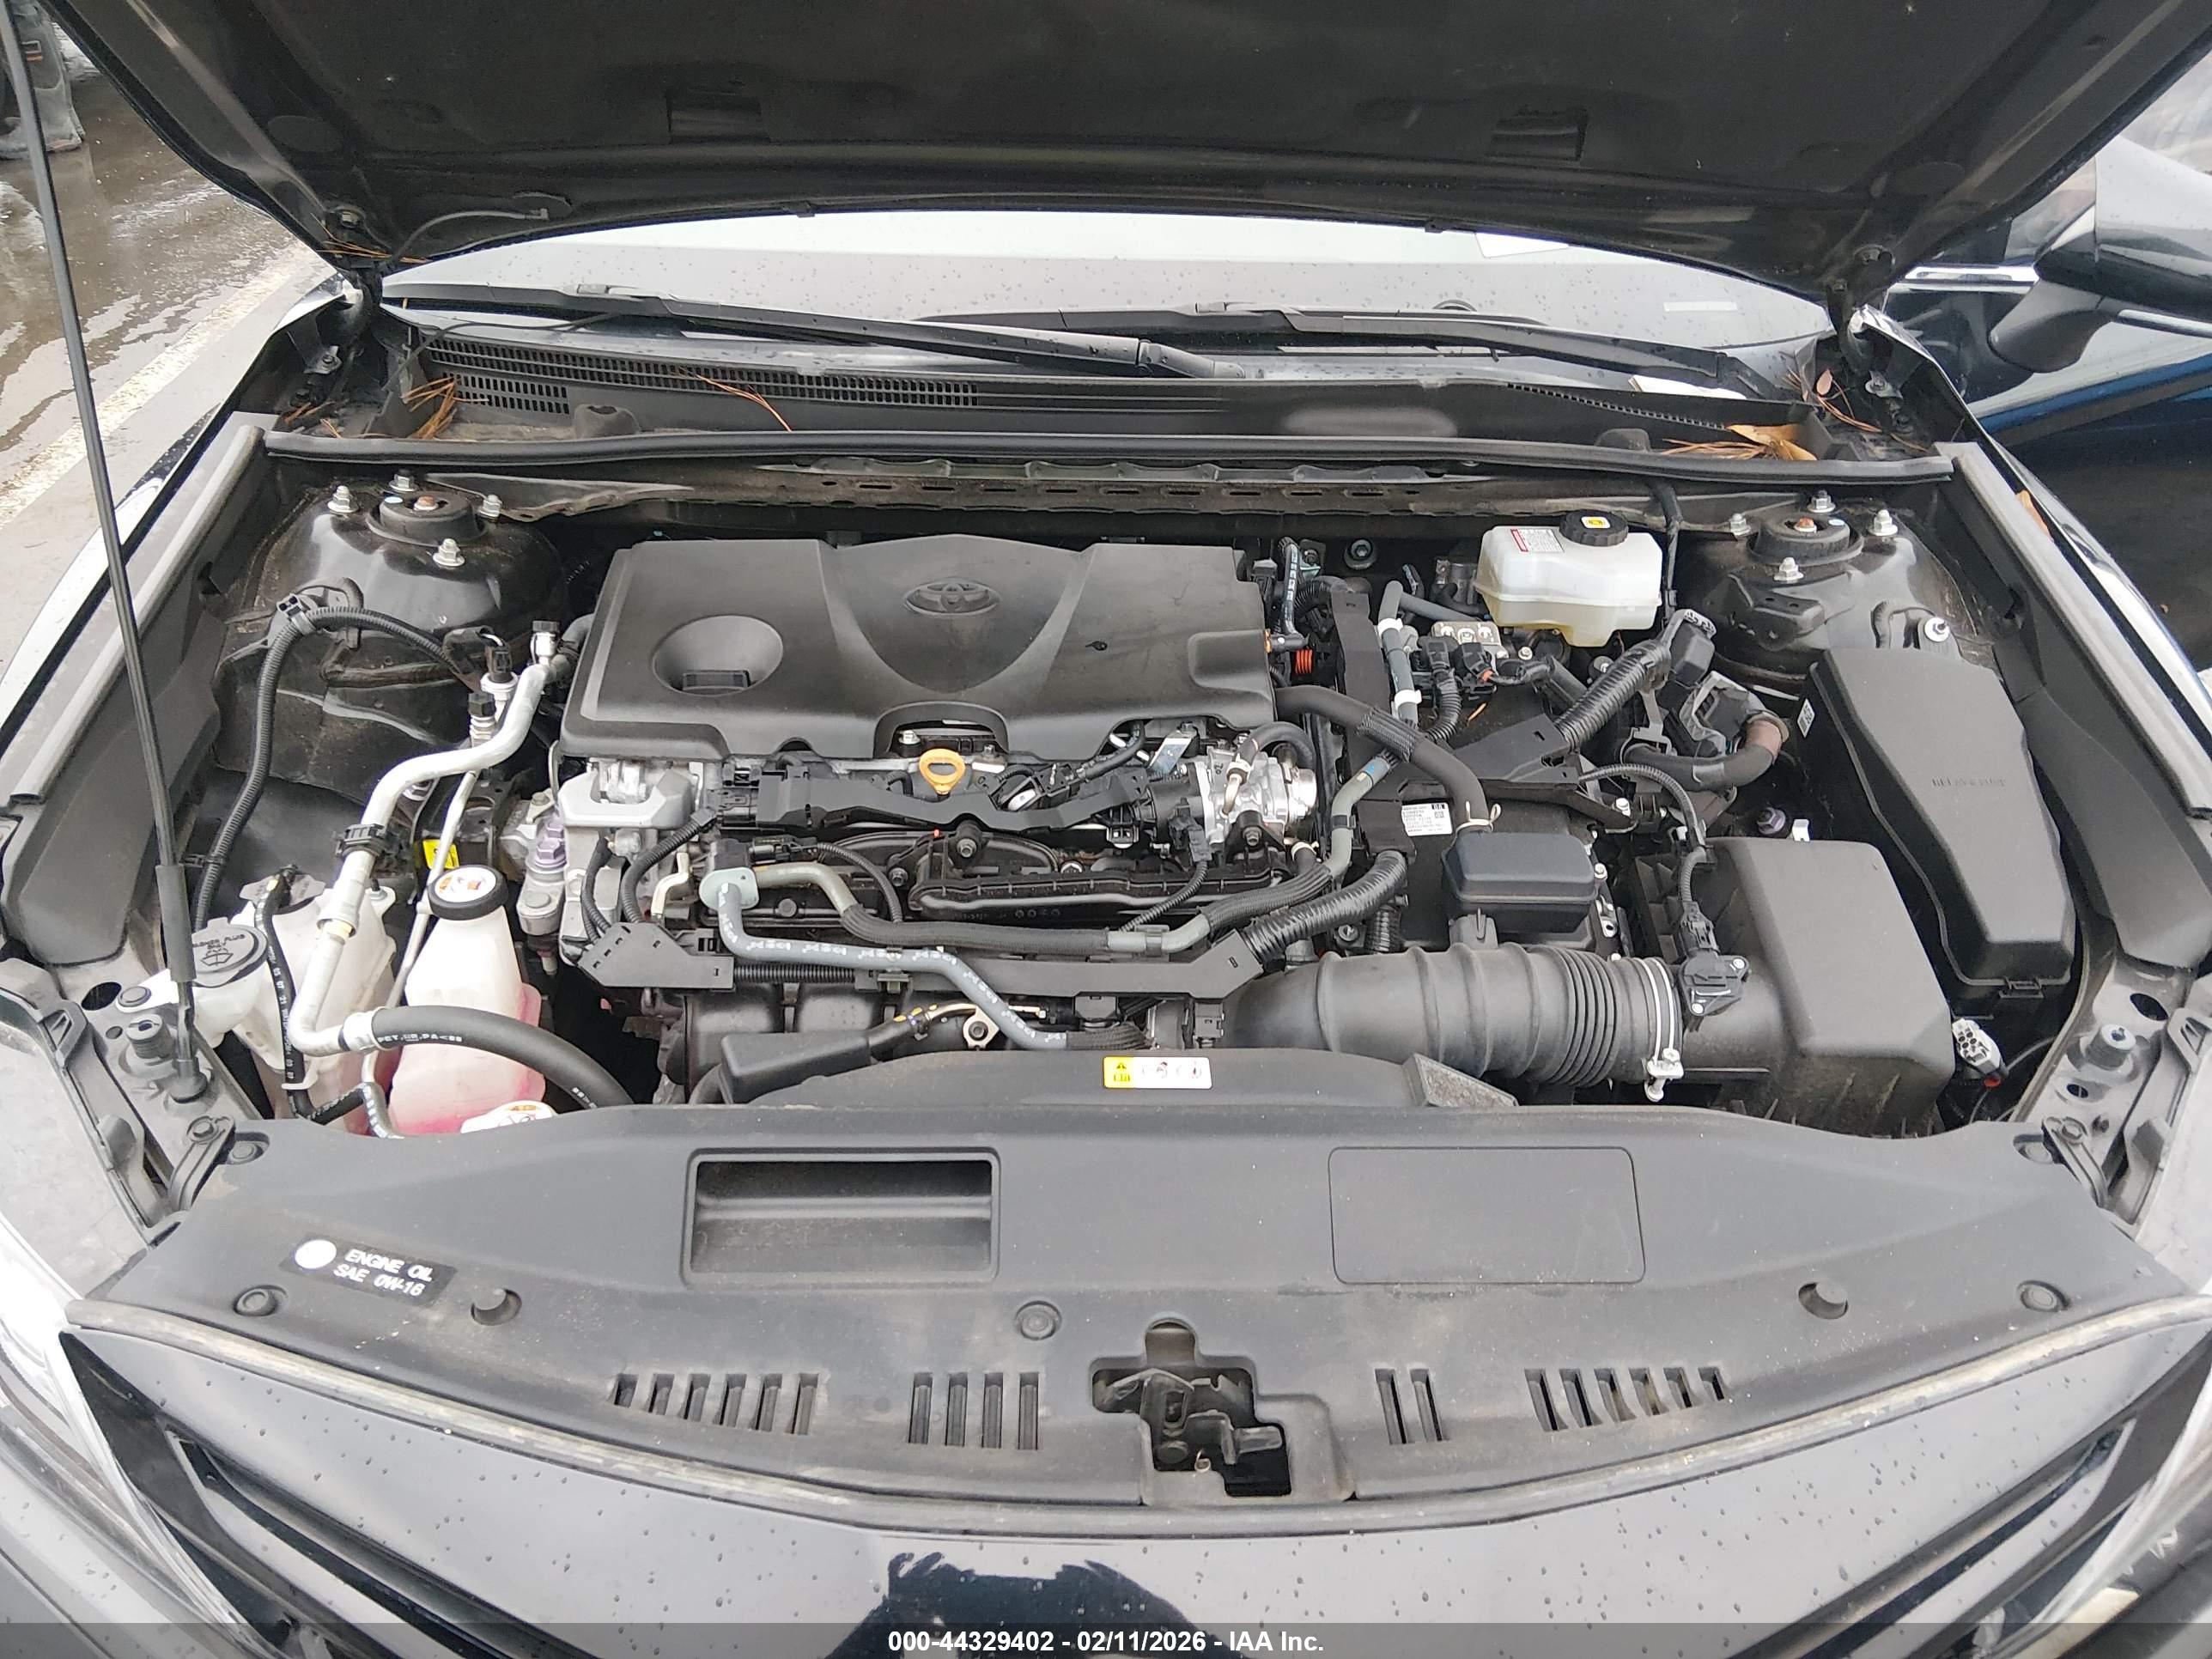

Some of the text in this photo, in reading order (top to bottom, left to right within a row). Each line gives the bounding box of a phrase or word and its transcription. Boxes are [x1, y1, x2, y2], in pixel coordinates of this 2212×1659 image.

[333, 1263, 425, 1297] SAE 0W-16
[345, 1249, 434, 1282] ENGINE OIL
